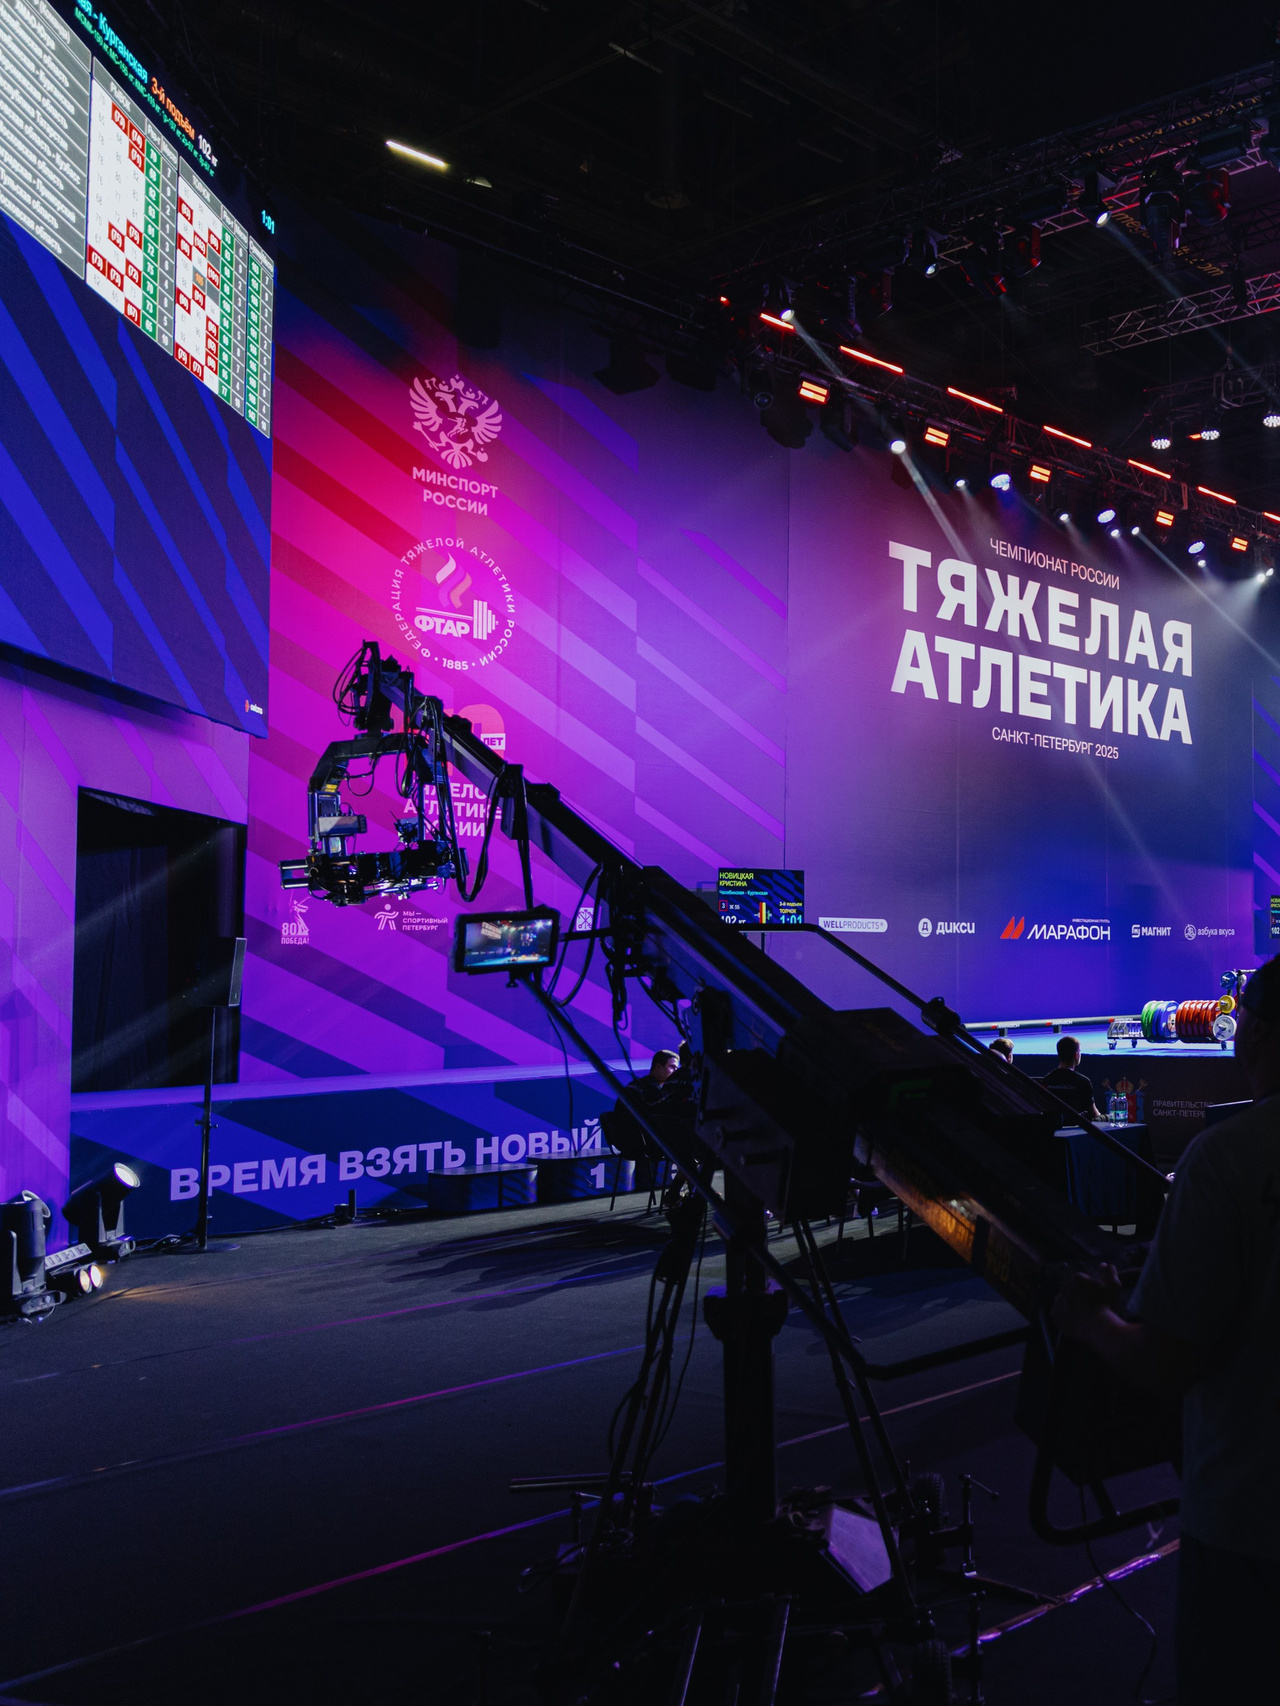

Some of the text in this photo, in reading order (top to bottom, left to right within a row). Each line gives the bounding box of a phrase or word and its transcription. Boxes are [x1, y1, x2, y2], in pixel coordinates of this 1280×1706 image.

[99, 12, 148, 84] Курганская
[198, 134, 212, 161] 102
[261, 209, 275, 234] 1:01
[412, 466, 498, 498] МИНСПОРТ
[423, 489, 488, 516] РОССИИ
[990, 537, 1120, 590] ЧЕМПИОНАТ РОССИИ
[391, 537, 516, 666] ФЕДЕРАЦИЯ ТЯЖЕЛОЙ АТЛЕТИКИ РОССИИ
[889, 540, 1192, 677] ТЯЖЕЛАЯ
[414, 615, 470, 637] ФТАР
[442, 658, 469, 670] 1885
[890, 629, 1193, 745] АТЛЕТИКА
[483, 736, 504, 746] ЛЕТ
[992, 726, 1119, 759] САНКТ-ПЕТЕРБУРГ 2025
[719, 872, 754, 880] НОВИЦКАЯ
[281, 922, 296, 936] 80
[780, 914, 802, 924] 1:01
[1141, 926, 1171, 936] МАГНИТ
[1197, 926, 1235, 937] азбука вкуса
[281, 937, 309, 945] ПОБЕДА!
[1027, 924, 1110, 940] МАРАФОН
[170, 1118, 602, 1201] ВРЕМЯ ВЗЯТЬ НОВЫЙ
[590, 1162, 605, 1189] 1
